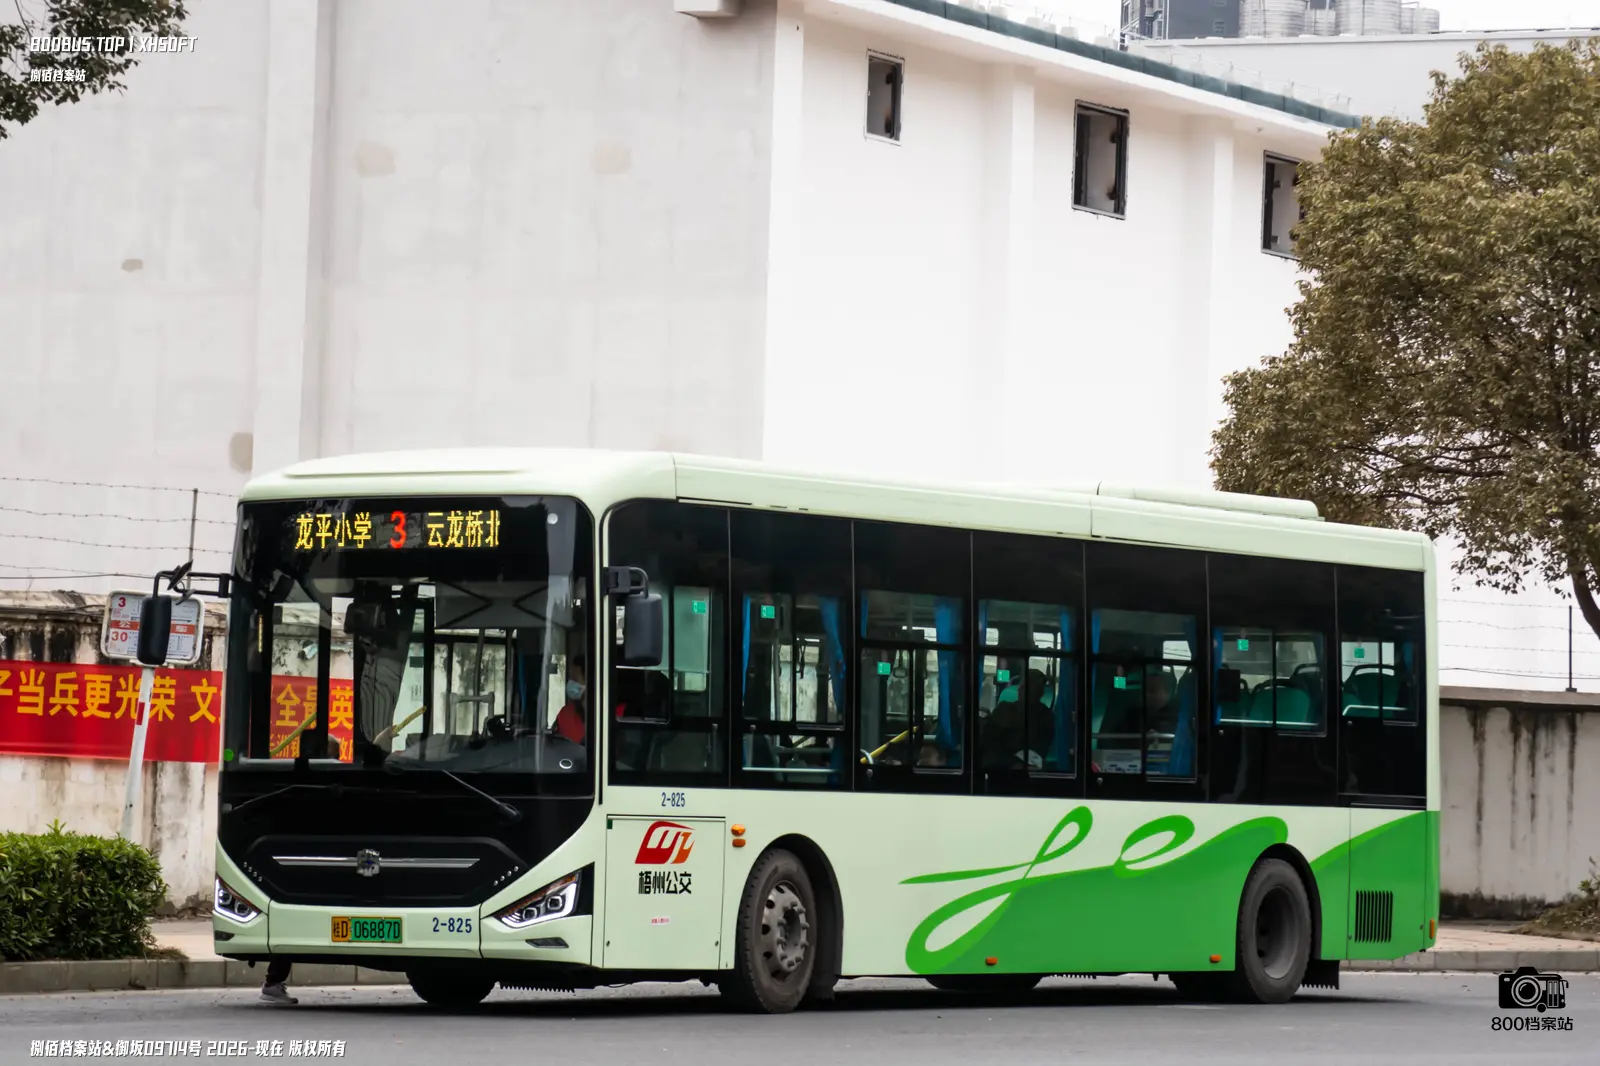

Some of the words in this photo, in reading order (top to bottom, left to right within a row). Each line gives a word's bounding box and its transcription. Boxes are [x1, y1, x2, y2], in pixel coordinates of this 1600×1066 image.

[295, 512, 372, 549] 龙平小学
[389, 510, 407, 549] 3
[427, 510, 500, 548] 云龙桥北
[118, 597, 126, 608] 3
[111, 631, 128, 642] 30
[189, 678, 221, 723] 文
[661, 792, 685, 807] 2-825
[638, 871, 692, 894] 梧州公交
[432, 917, 472, 933] 2-825
